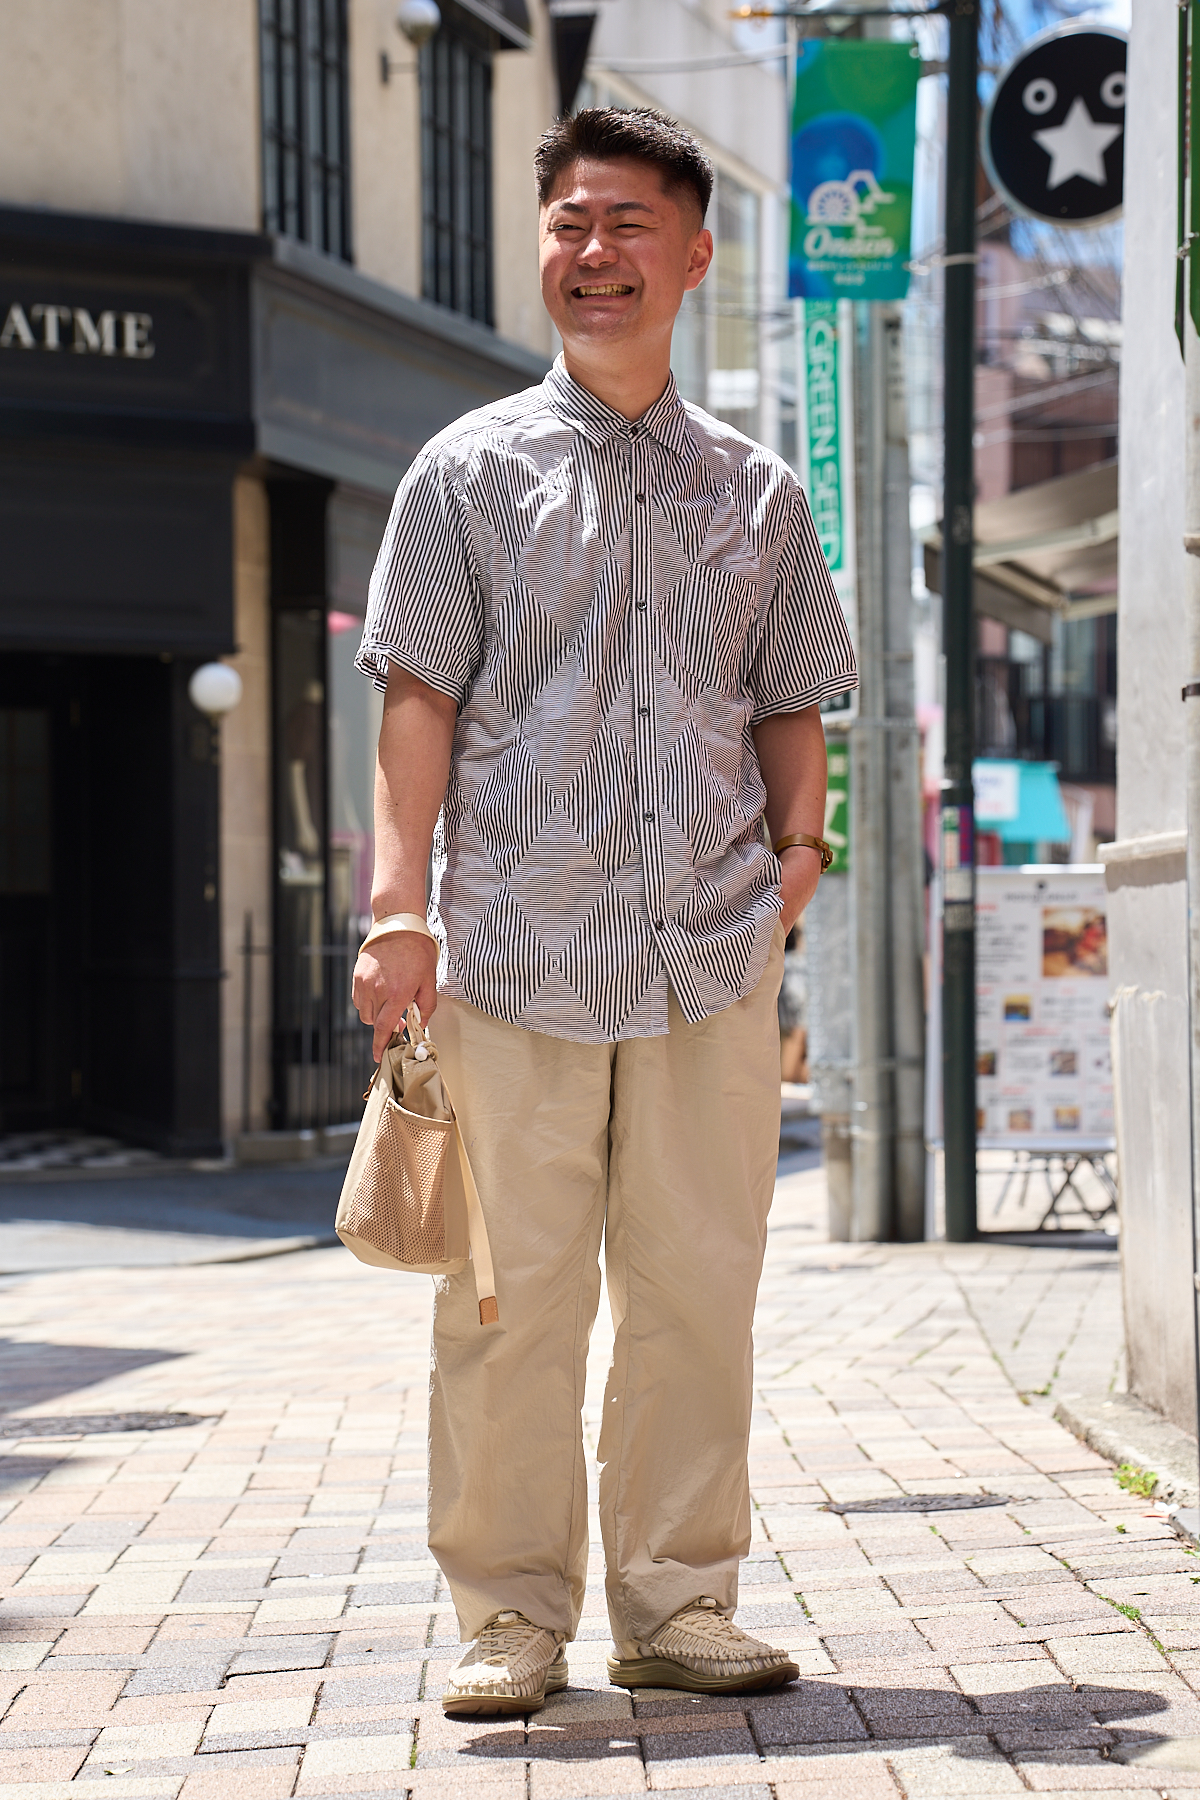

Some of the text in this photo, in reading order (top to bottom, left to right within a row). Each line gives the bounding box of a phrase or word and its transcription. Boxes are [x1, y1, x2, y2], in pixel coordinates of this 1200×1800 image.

[0, 303, 154, 359] ATME
[808, 320, 836, 459] GREEN
[812, 461, 841, 568] SEED
